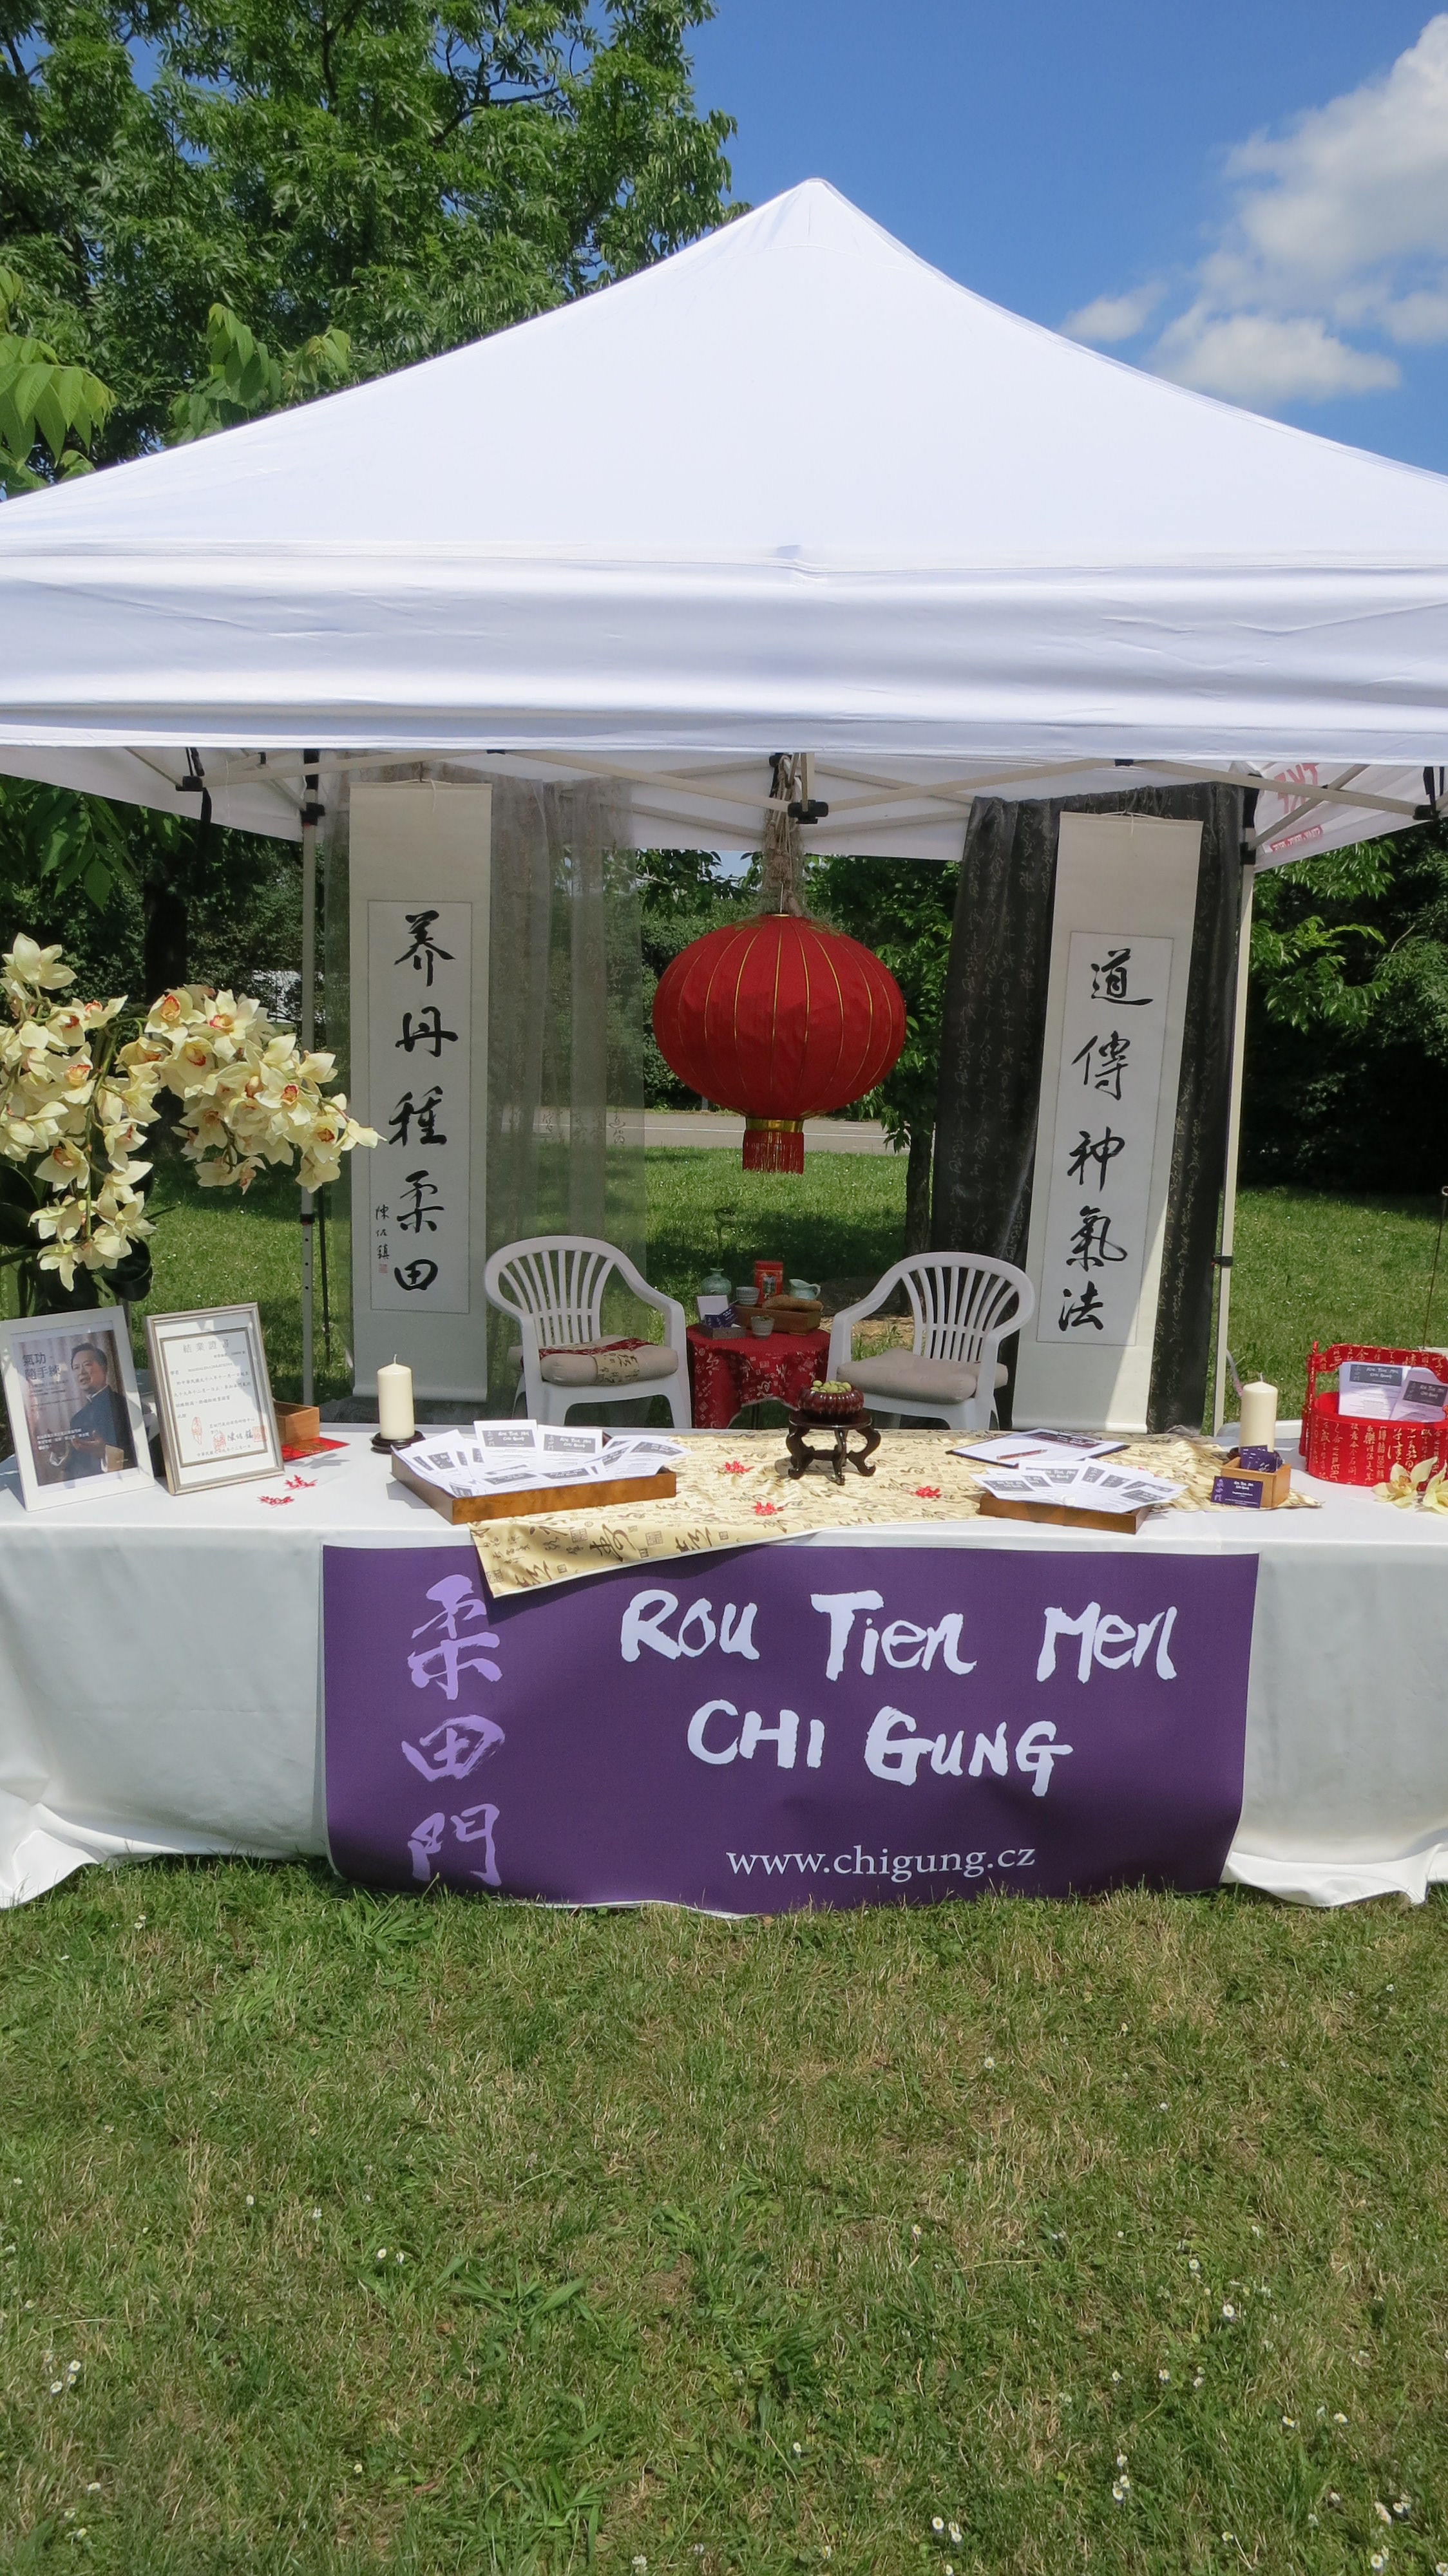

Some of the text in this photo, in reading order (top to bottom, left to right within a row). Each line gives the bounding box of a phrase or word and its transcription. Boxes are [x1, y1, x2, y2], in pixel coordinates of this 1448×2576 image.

[810, 1589, 978, 1681] Tien
[1036, 1601, 1178, 1684] Men
[401, 1573, 506, 1887] 柔田門
[687, 1699, 826, 1768] CHI
[726, 1845, 1035, 1883] www.chigung.cz
